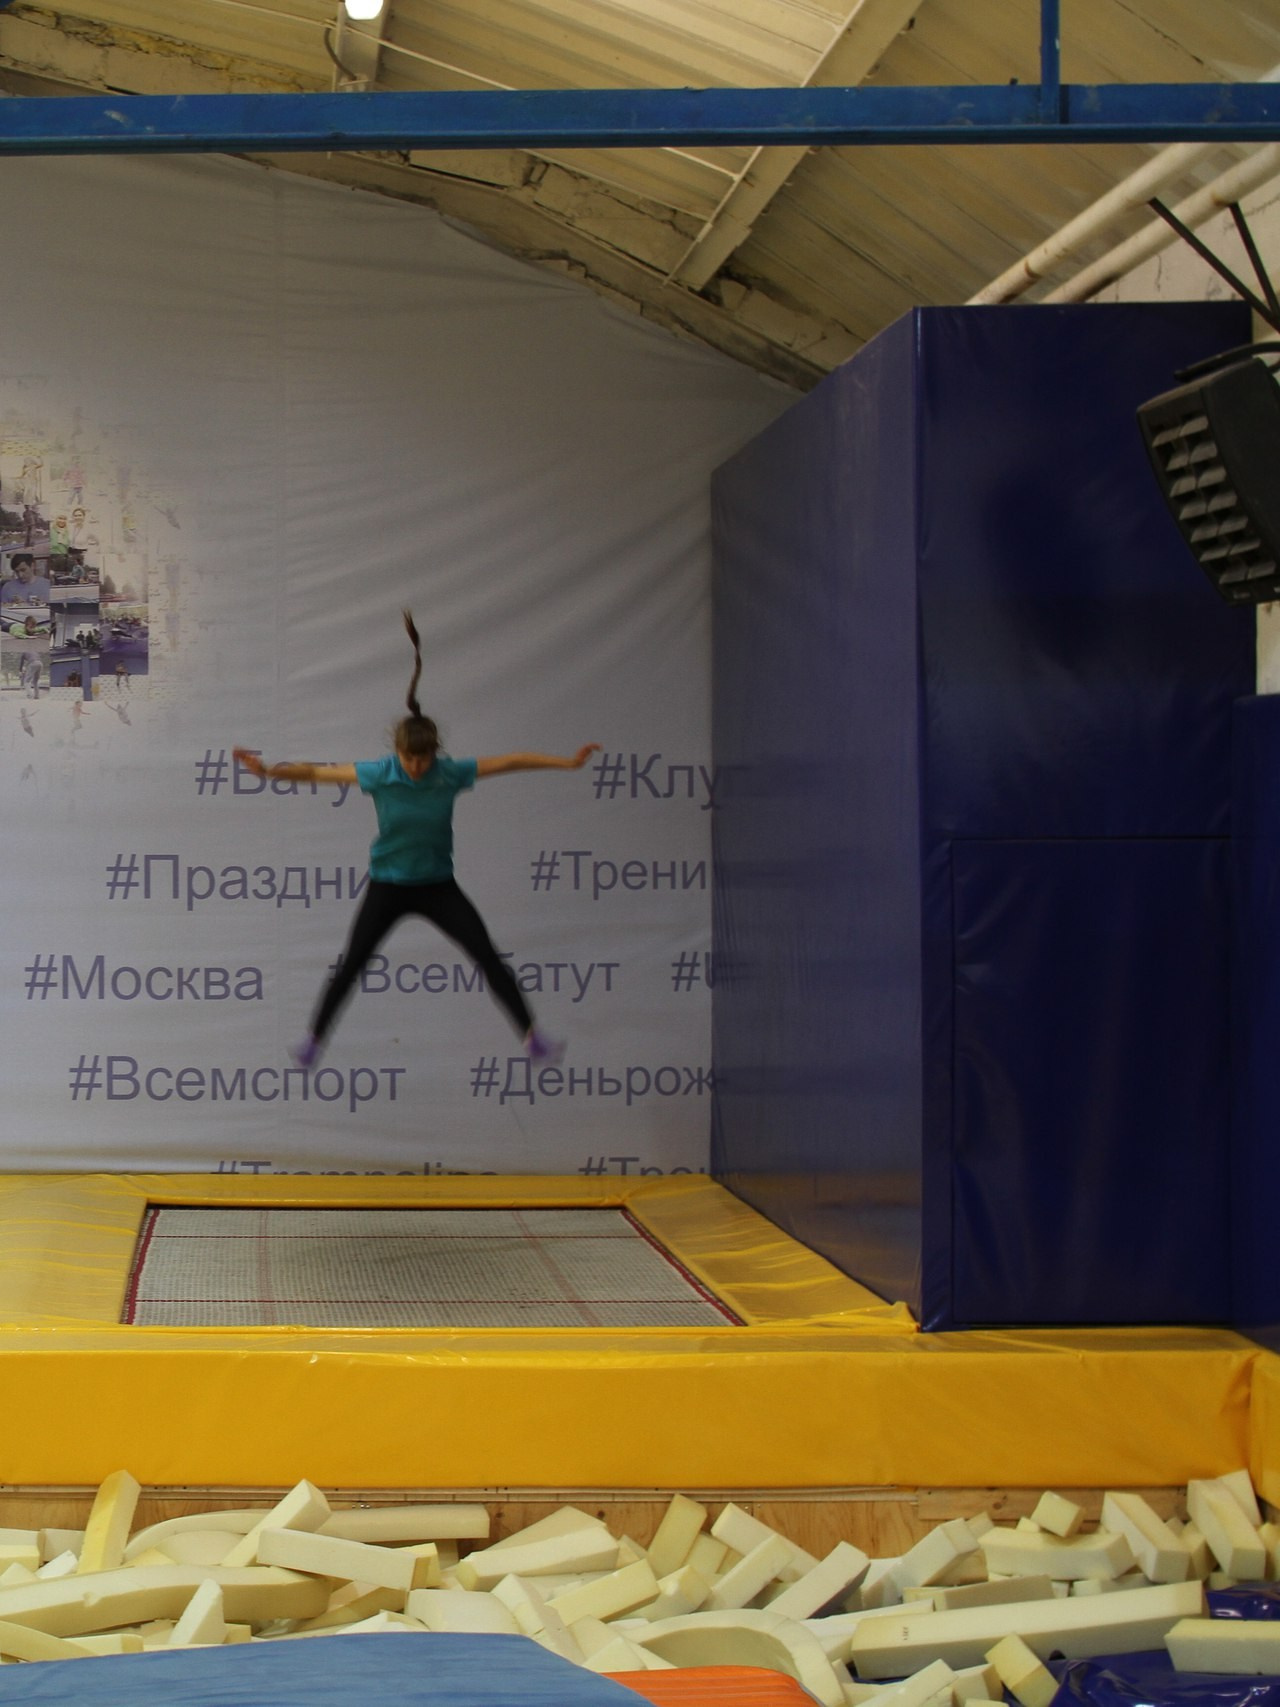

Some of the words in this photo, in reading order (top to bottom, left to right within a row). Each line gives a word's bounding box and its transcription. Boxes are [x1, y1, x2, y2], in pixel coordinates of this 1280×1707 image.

[531, 851, 707, 900] #Трени
[24, 954, 264, 1001] #Москва
[69, 1055, 407, 1113] #Всемспорт
